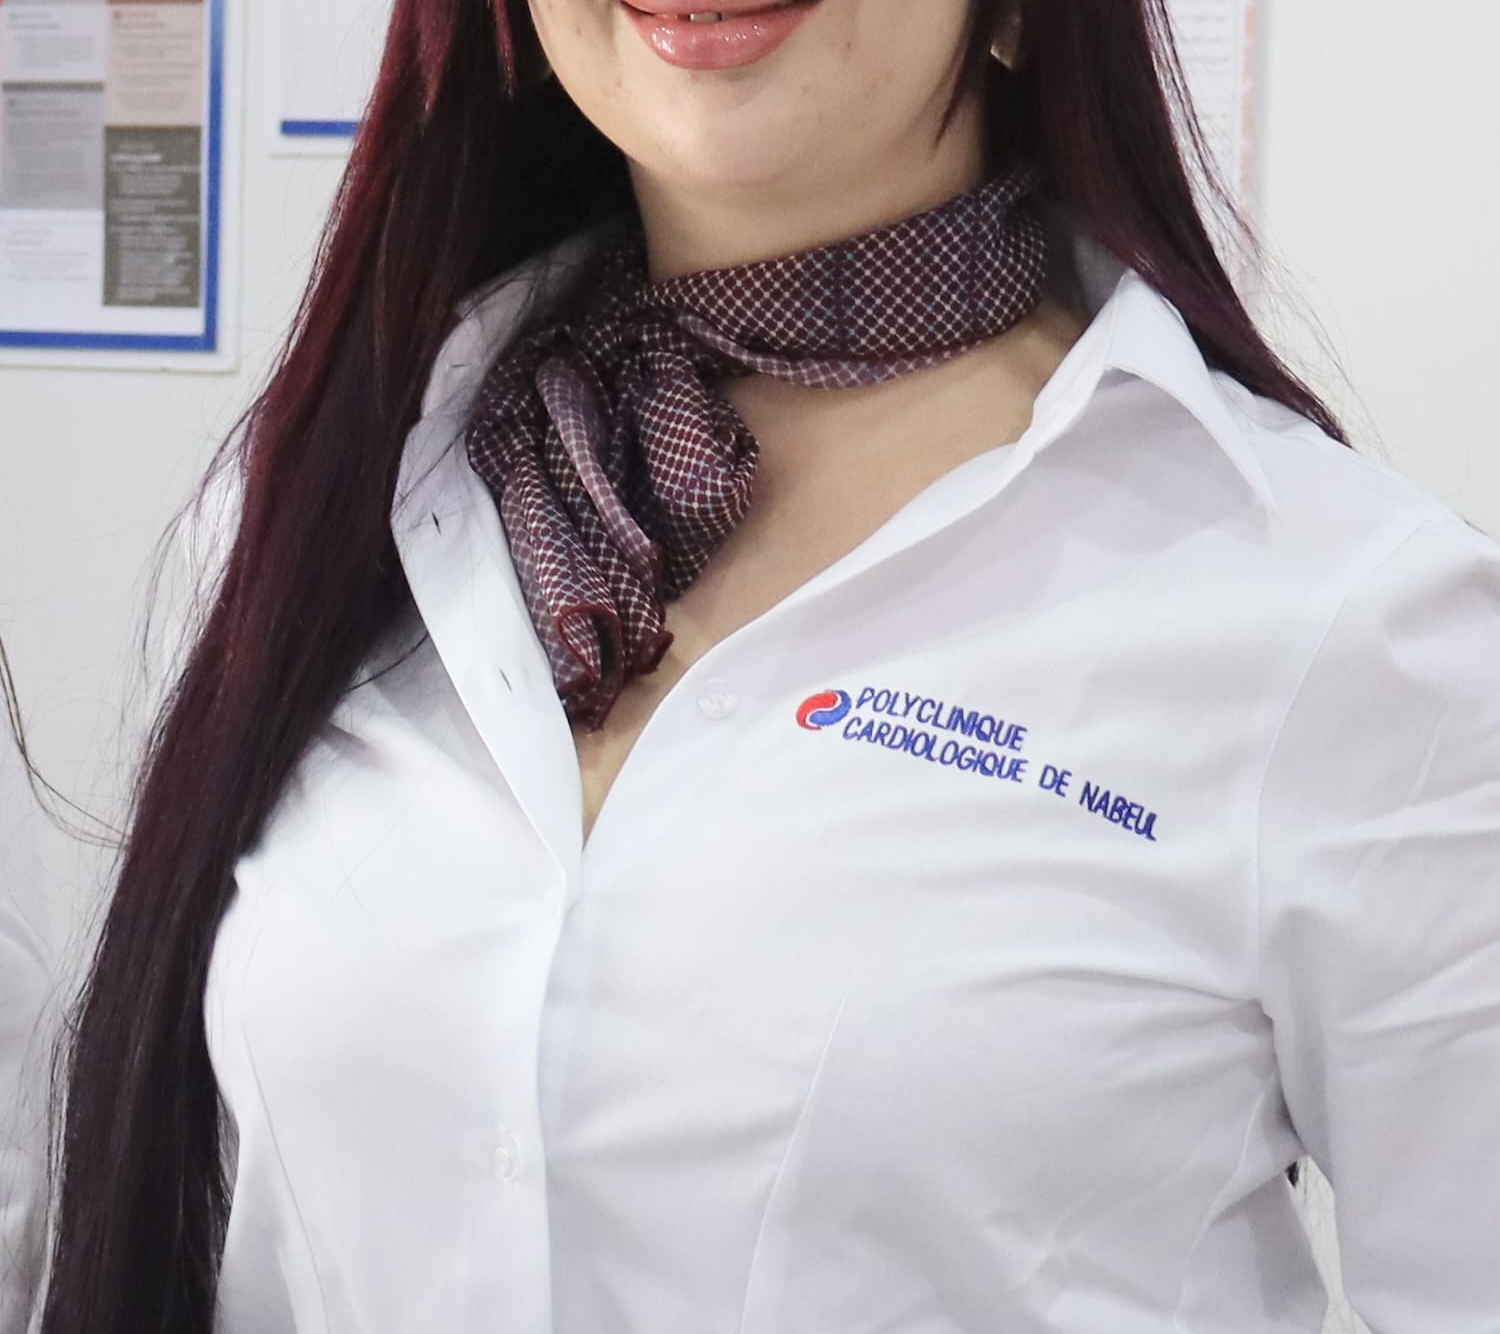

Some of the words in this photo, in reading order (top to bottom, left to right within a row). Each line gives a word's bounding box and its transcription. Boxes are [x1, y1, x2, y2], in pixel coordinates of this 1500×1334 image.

[856, 686, 1028, 752] POLYCLINIQUE
[842, 716, 1029, 784] CARDIOLOGIQUE
[1038, 763, 1073, 798] DE
[1079, 780, 1159, 842] NABEUL
